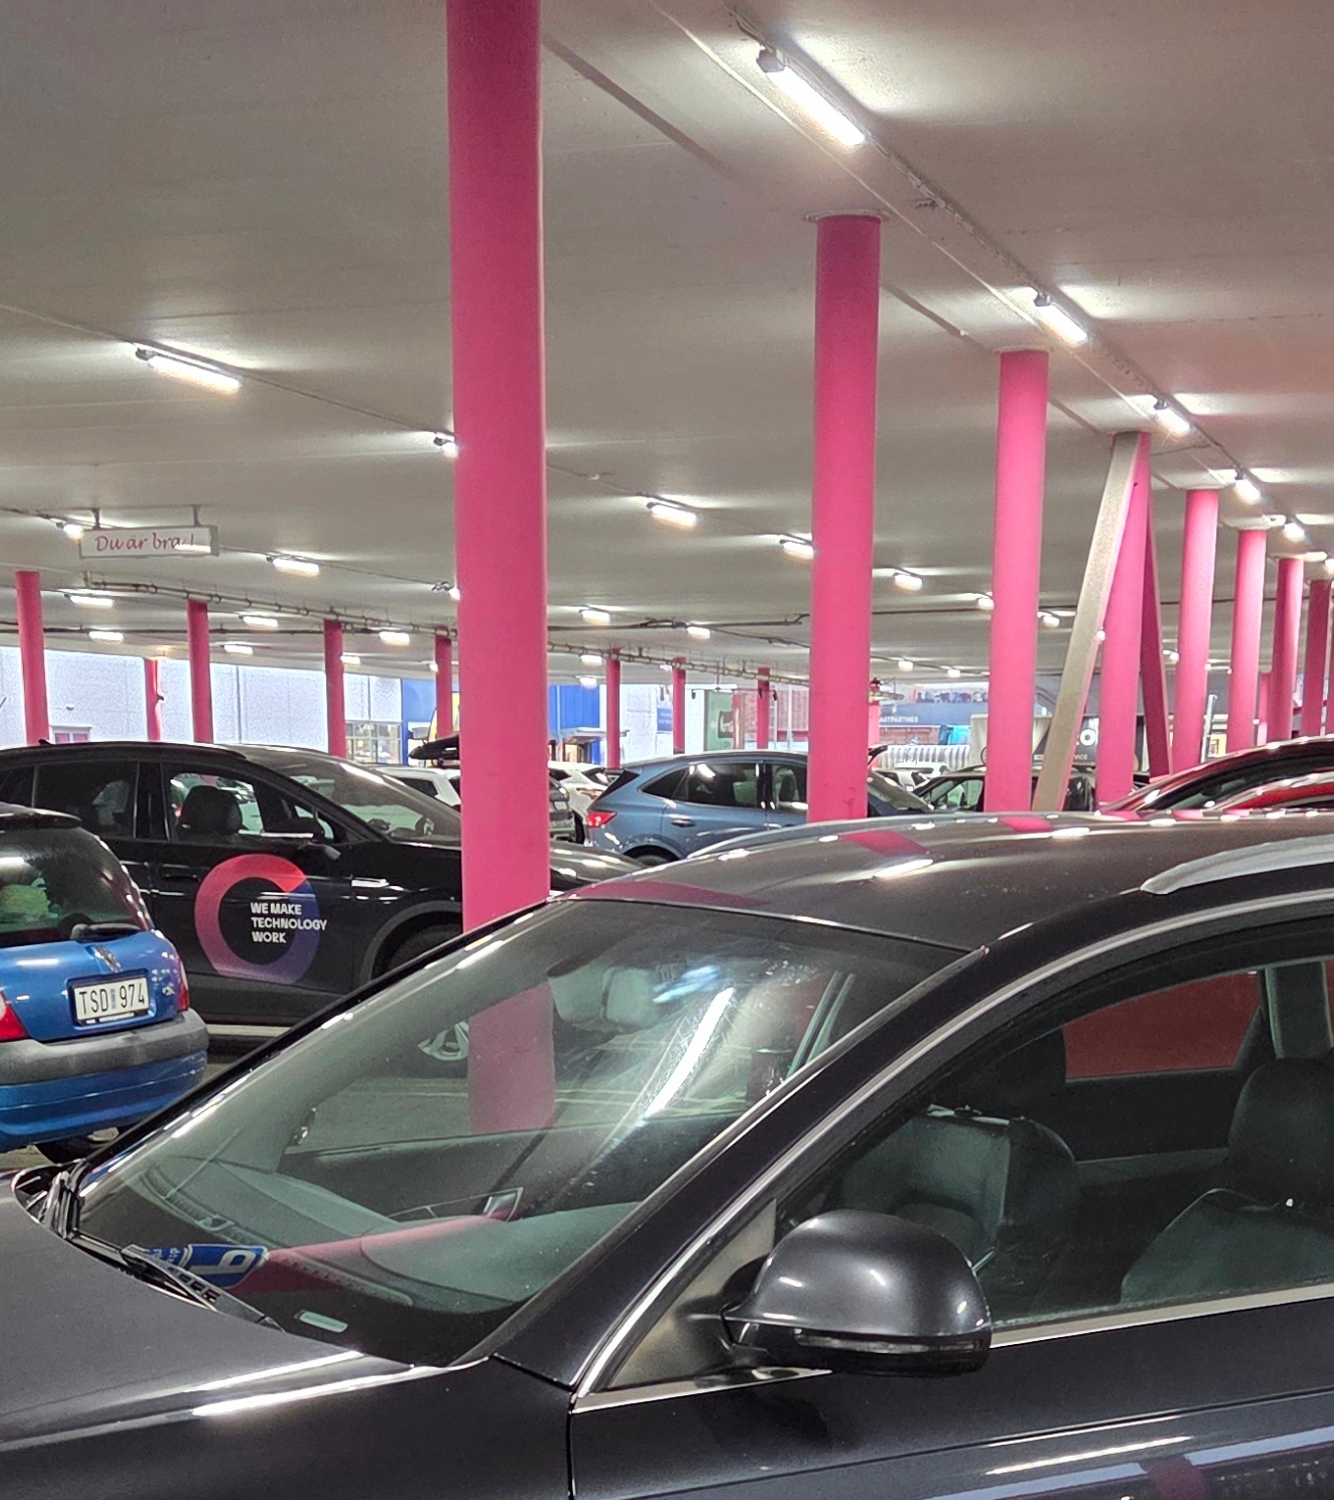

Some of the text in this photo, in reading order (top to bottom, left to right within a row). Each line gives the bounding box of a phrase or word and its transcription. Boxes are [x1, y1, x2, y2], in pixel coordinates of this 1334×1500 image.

[95, 535, 125, 552] Du
[127, 534, 148, 550] är
[250, 902, 302, 915] WE MAKE
[251, 917, 327, 931] TECHNOLOGY
[252, 931, 286, 943] WORK
[79, 983, 145, 1015] TSD 974
